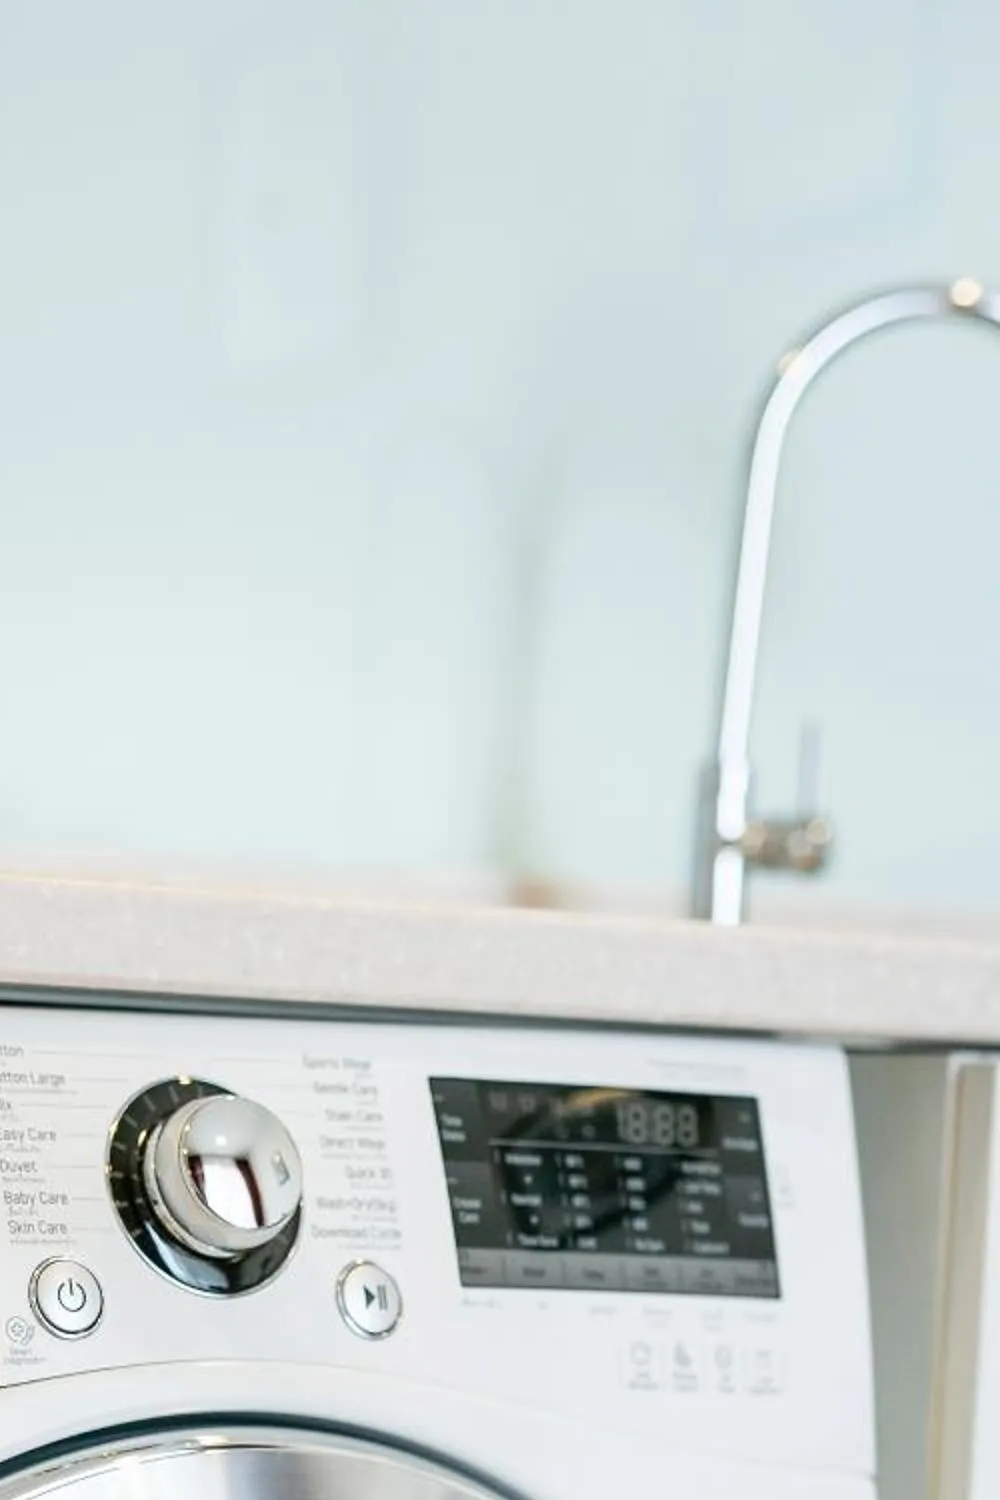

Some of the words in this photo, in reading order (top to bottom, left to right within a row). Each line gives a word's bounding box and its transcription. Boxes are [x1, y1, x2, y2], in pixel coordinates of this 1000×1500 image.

[0, 1158, 38, 1174] Duvet
[3, 1189, 36, 1208] Baby
[38, 1190, 69, 1206] Care
[7, 1219, 35, 1235] Skin
[37, 1219, 68, 1235] Care
